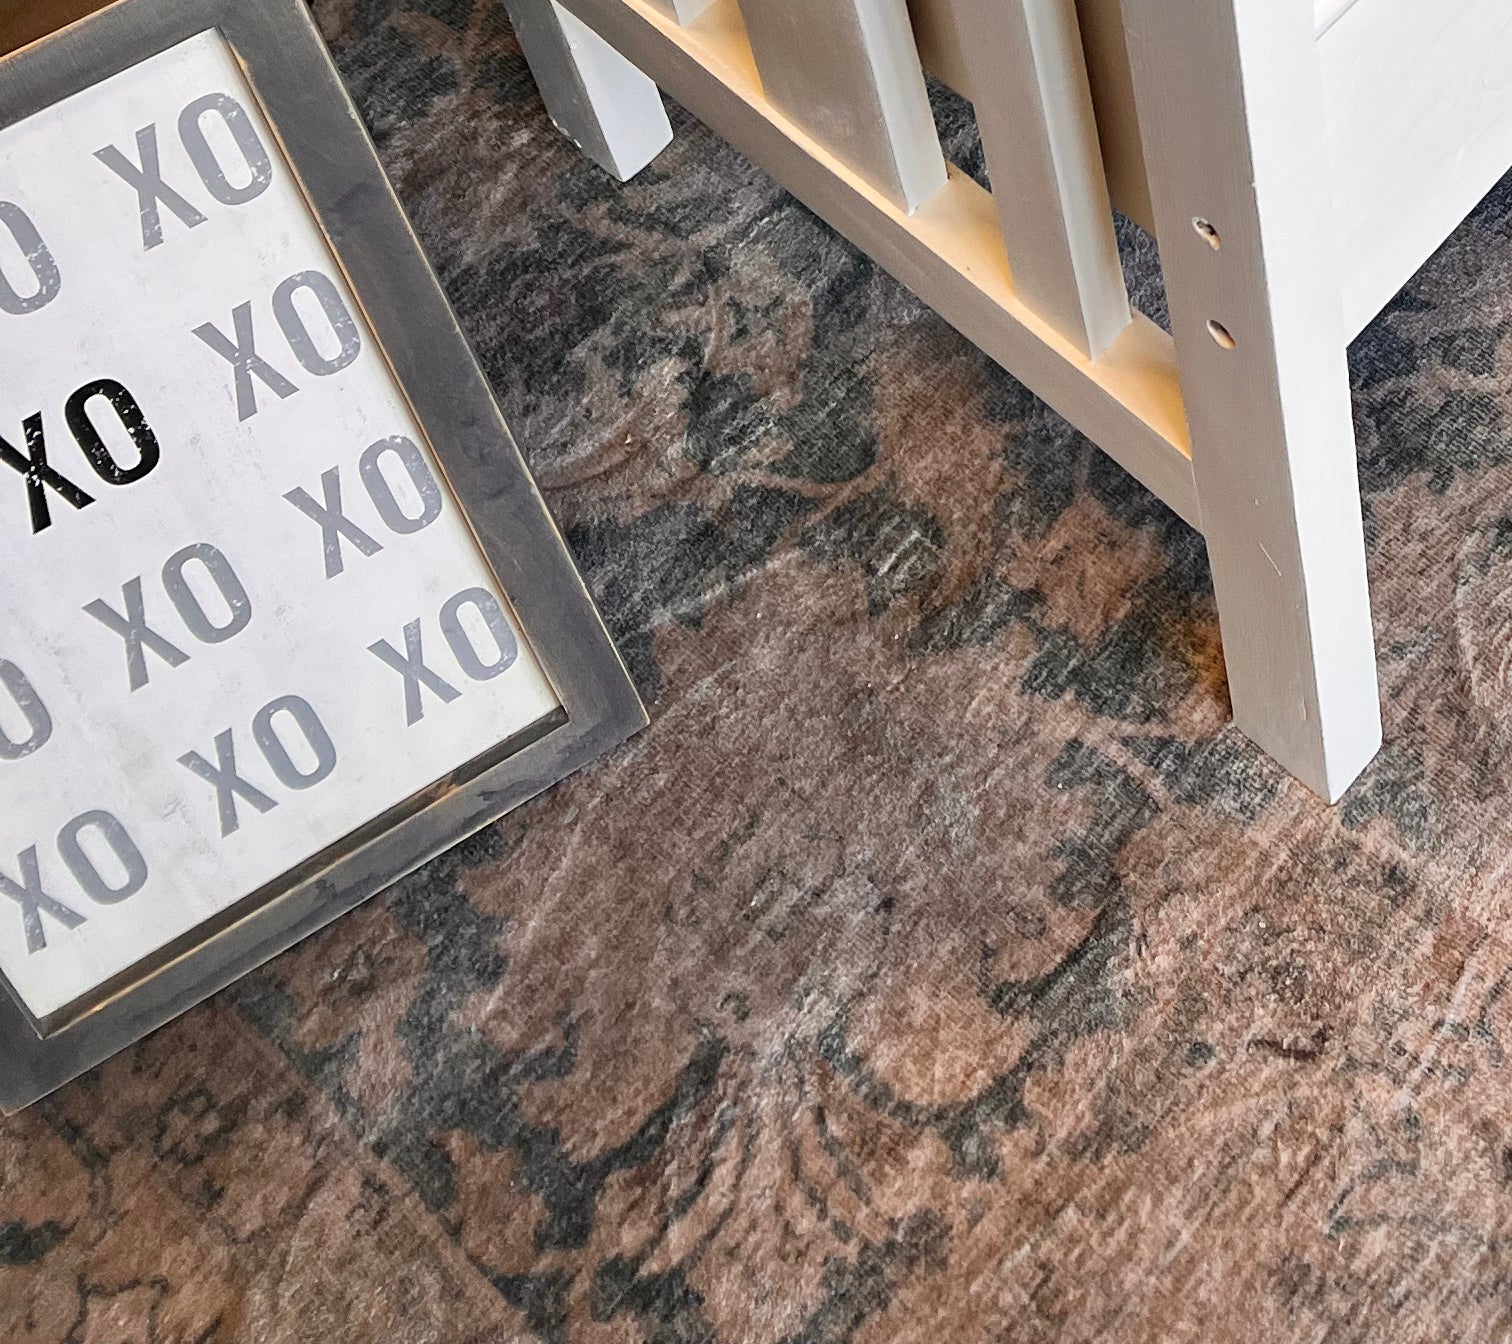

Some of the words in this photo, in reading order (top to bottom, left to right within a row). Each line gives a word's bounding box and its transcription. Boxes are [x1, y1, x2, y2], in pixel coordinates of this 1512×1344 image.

[92, 92, 272, 252] XO
[0, 378, 160, 535] XO
[190, 270, 361, 422] XO
[81, 542, 252, 693] XO
[282, 435, 443, 579] XO
[0, 809, 148, 955] XO
[176, 694, 337, 839] XO
[367, 587, 519, 727] XO
